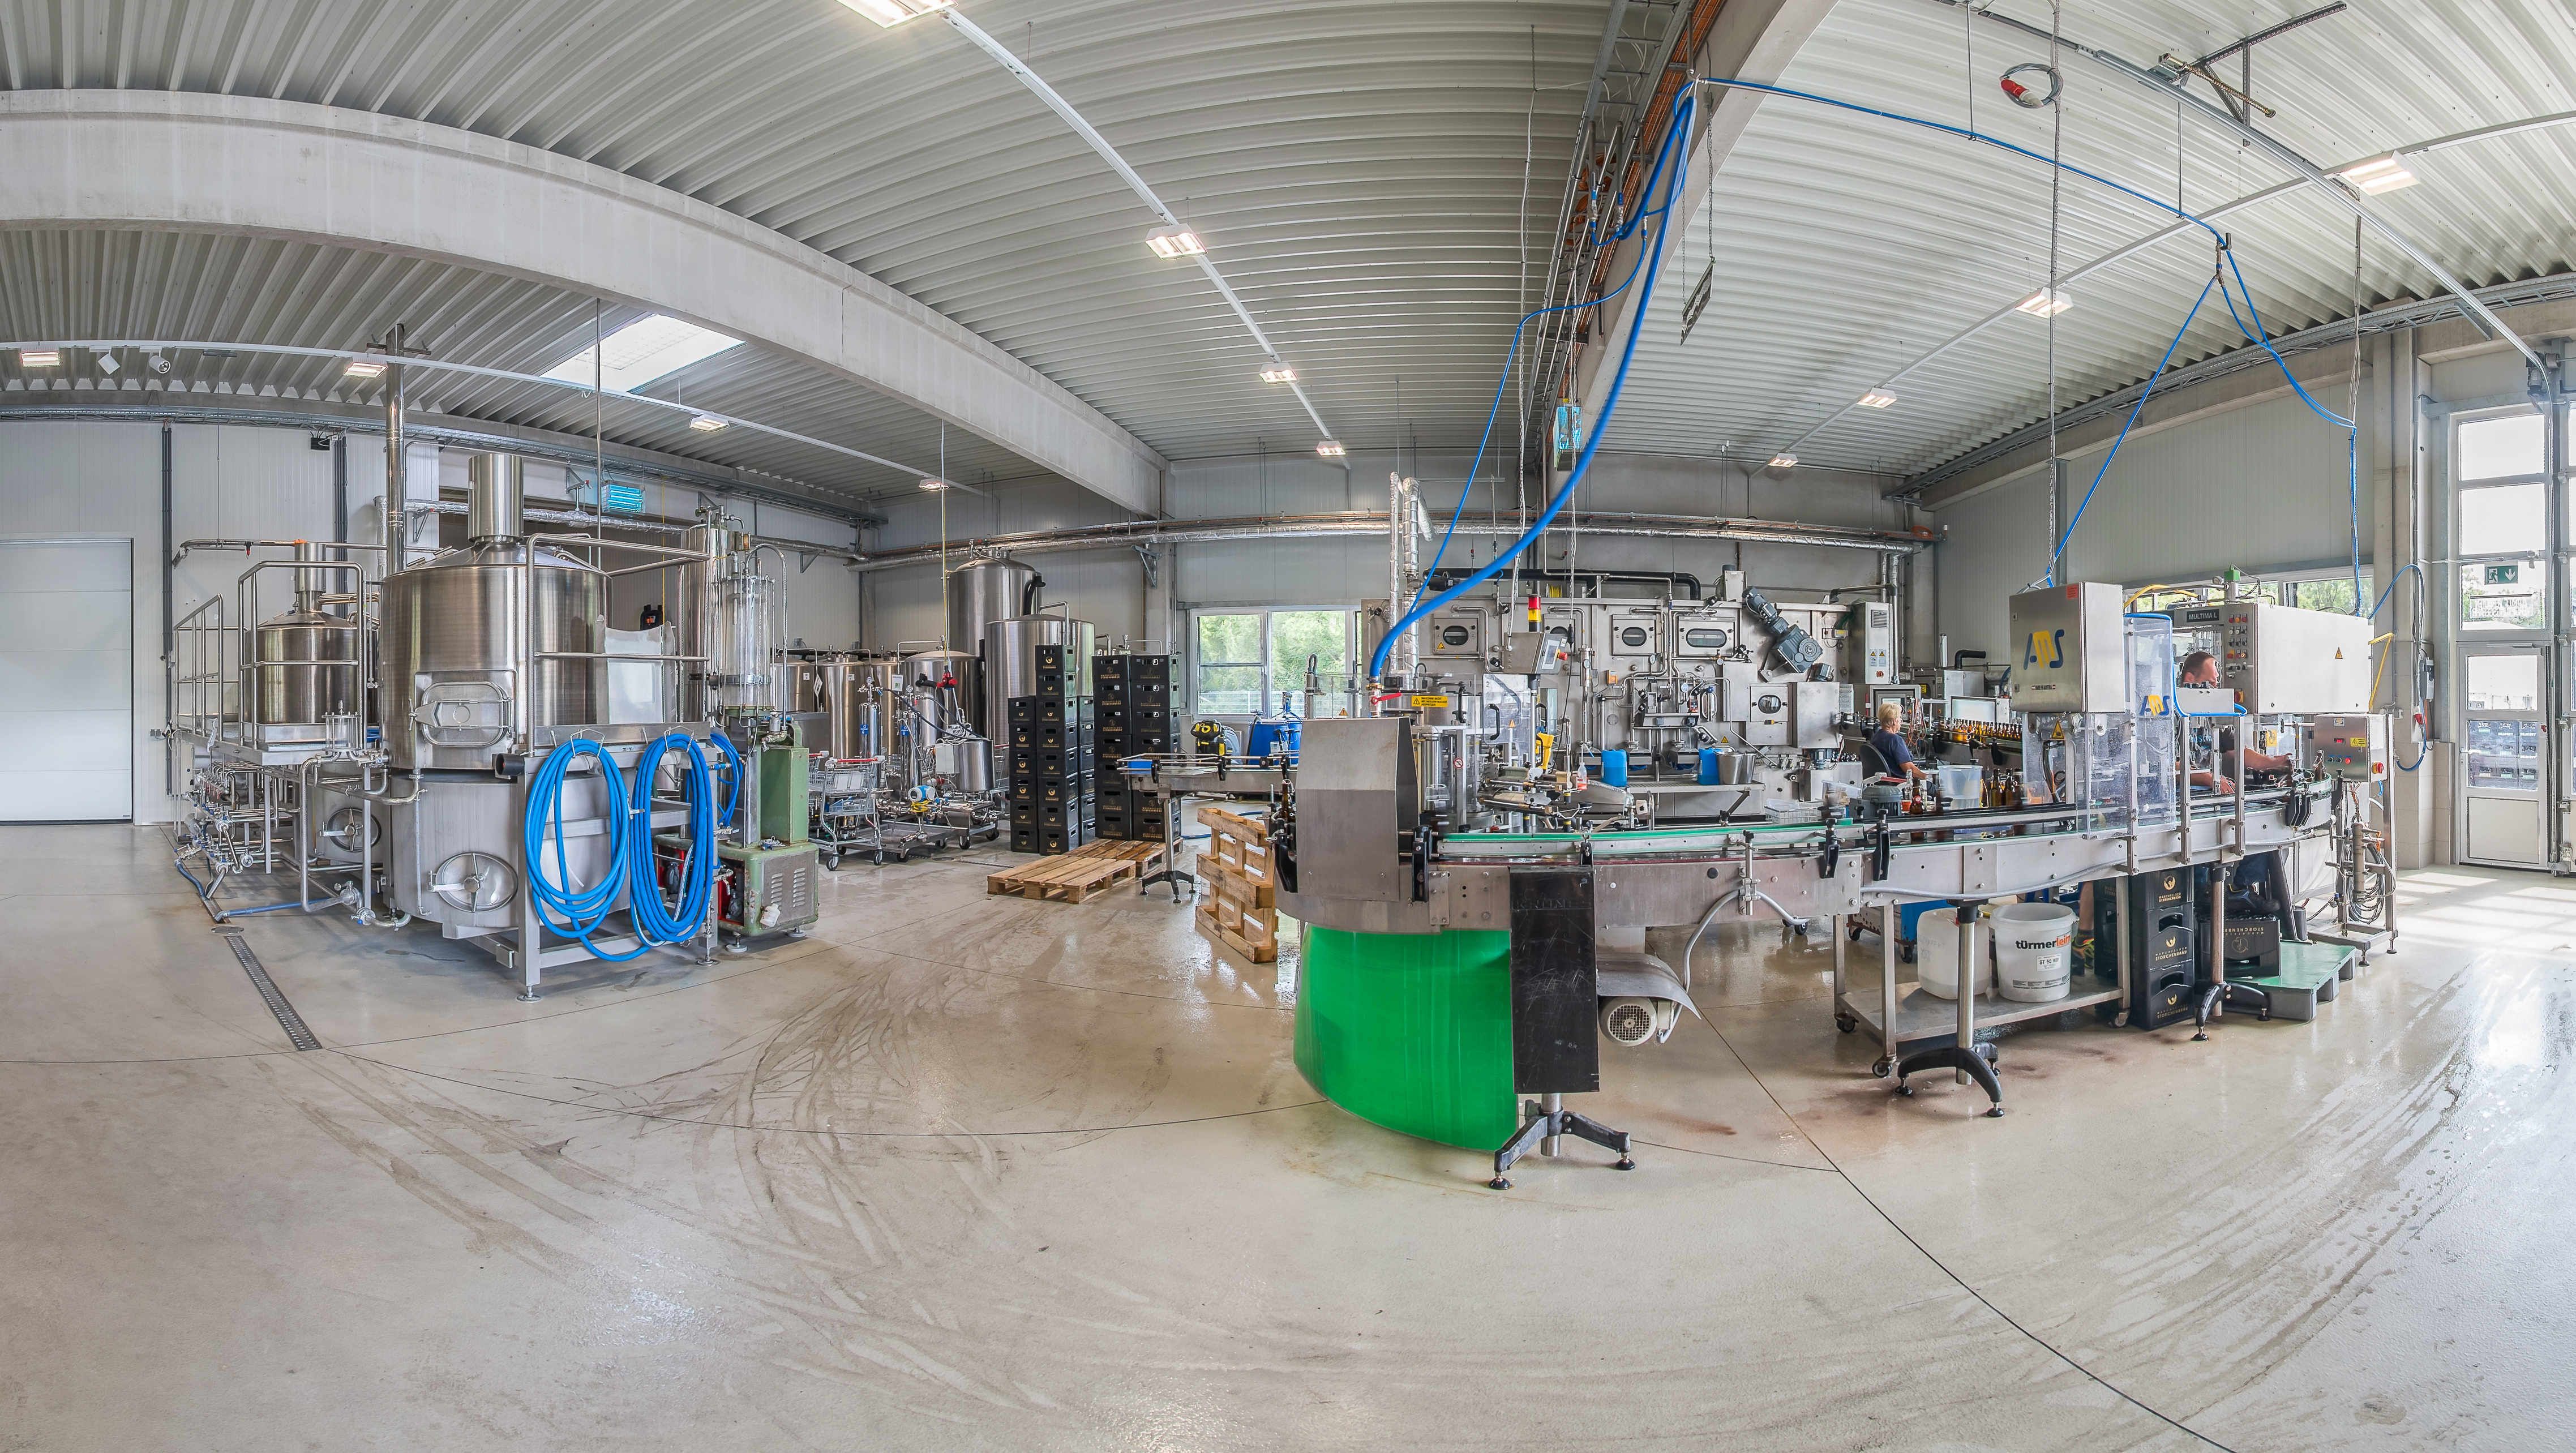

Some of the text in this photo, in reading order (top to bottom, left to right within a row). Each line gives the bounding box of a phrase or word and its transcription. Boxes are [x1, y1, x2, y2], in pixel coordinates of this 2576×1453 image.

[2189, 611, 2213, 620] MULTIMA
[2023, 629, 2065, 671] AMS
[2139, 694, 2170, 717] AMS
[2016, 935, 2071, 949] türmerleim
[2155, 950, 2187, 961] STORCHENBRÄU
